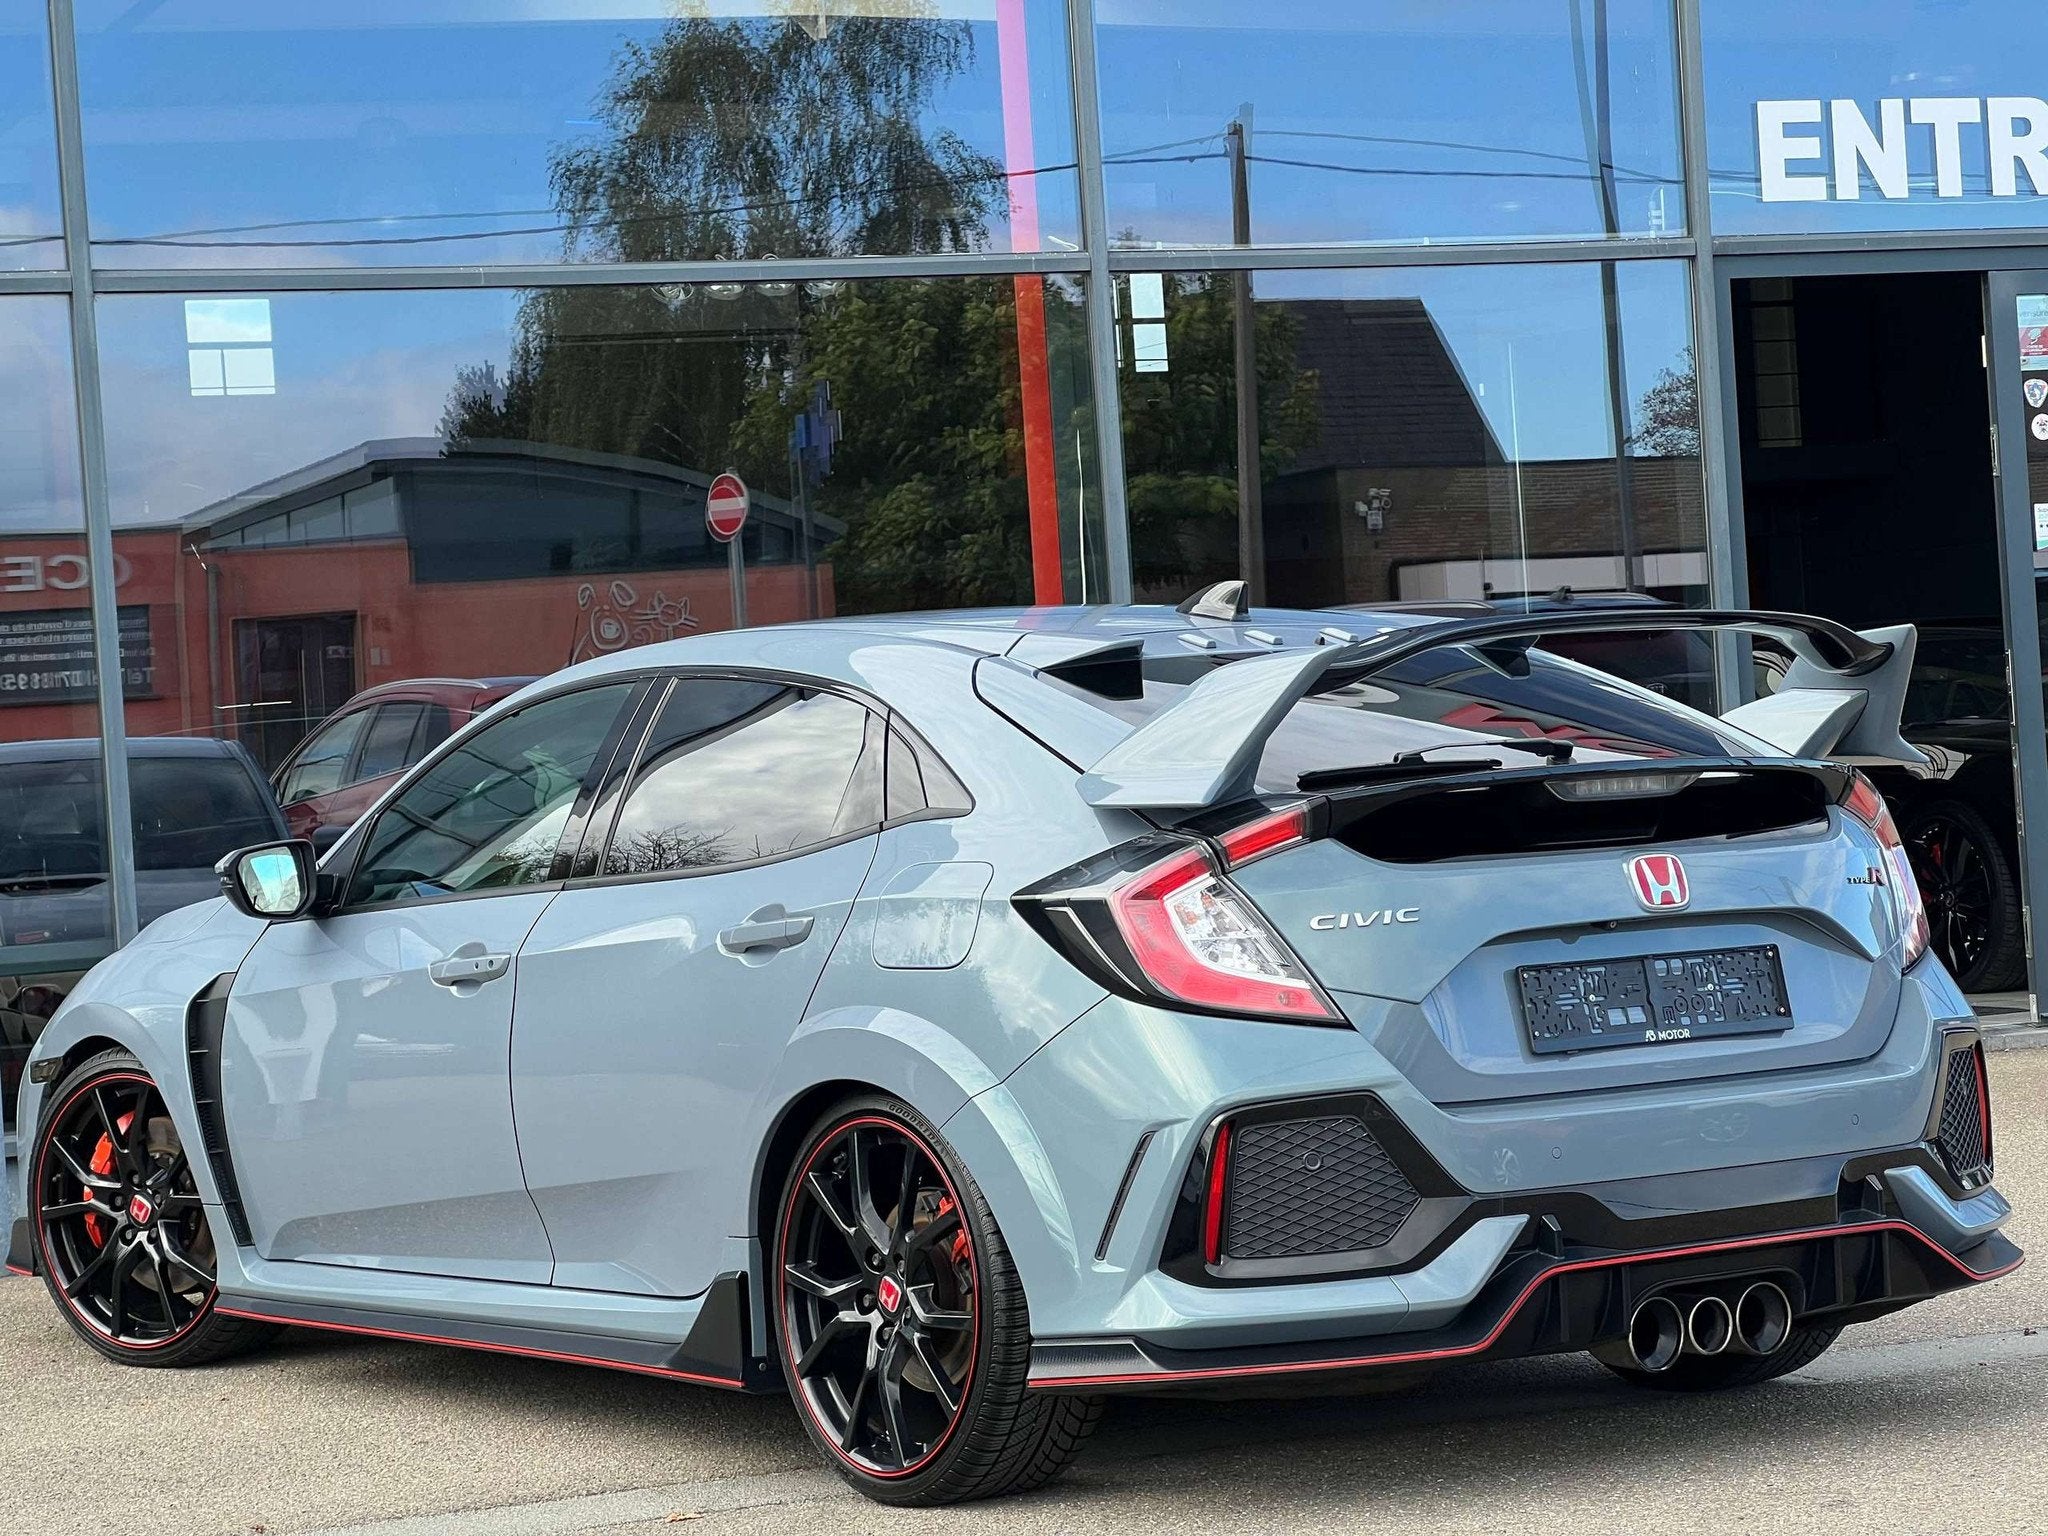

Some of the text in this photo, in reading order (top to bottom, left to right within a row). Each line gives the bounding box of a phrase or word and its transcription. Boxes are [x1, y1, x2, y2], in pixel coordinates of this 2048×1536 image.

[1756, 97, 2048, 202] ENTR
[1309, 907, 1420, 931] CIVIC
[1657, 1028, 1691, 1041] MOTOR
